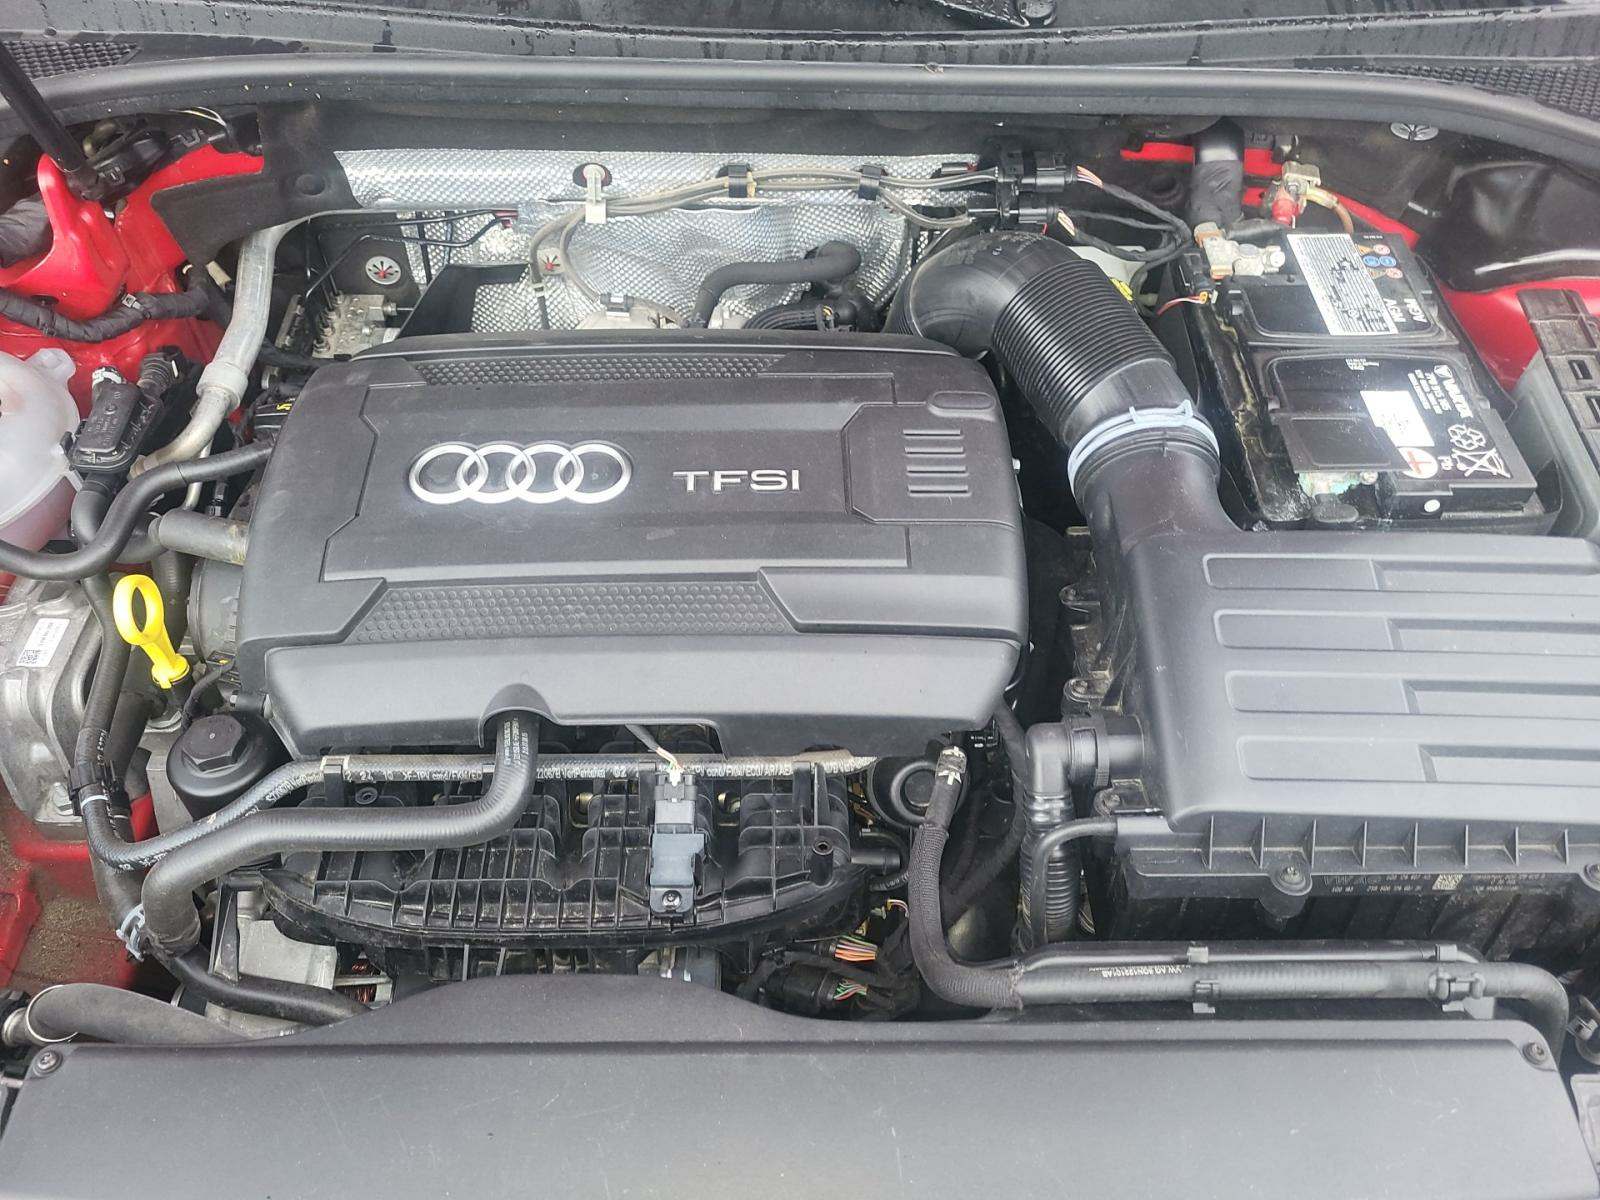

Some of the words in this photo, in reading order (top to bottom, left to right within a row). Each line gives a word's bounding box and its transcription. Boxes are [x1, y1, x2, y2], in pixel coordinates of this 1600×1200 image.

[1383, 298, 1406, 322] AGM
[1404, 298, 1428, 323] AGM
[672, 469, 800, 492] TFSI
